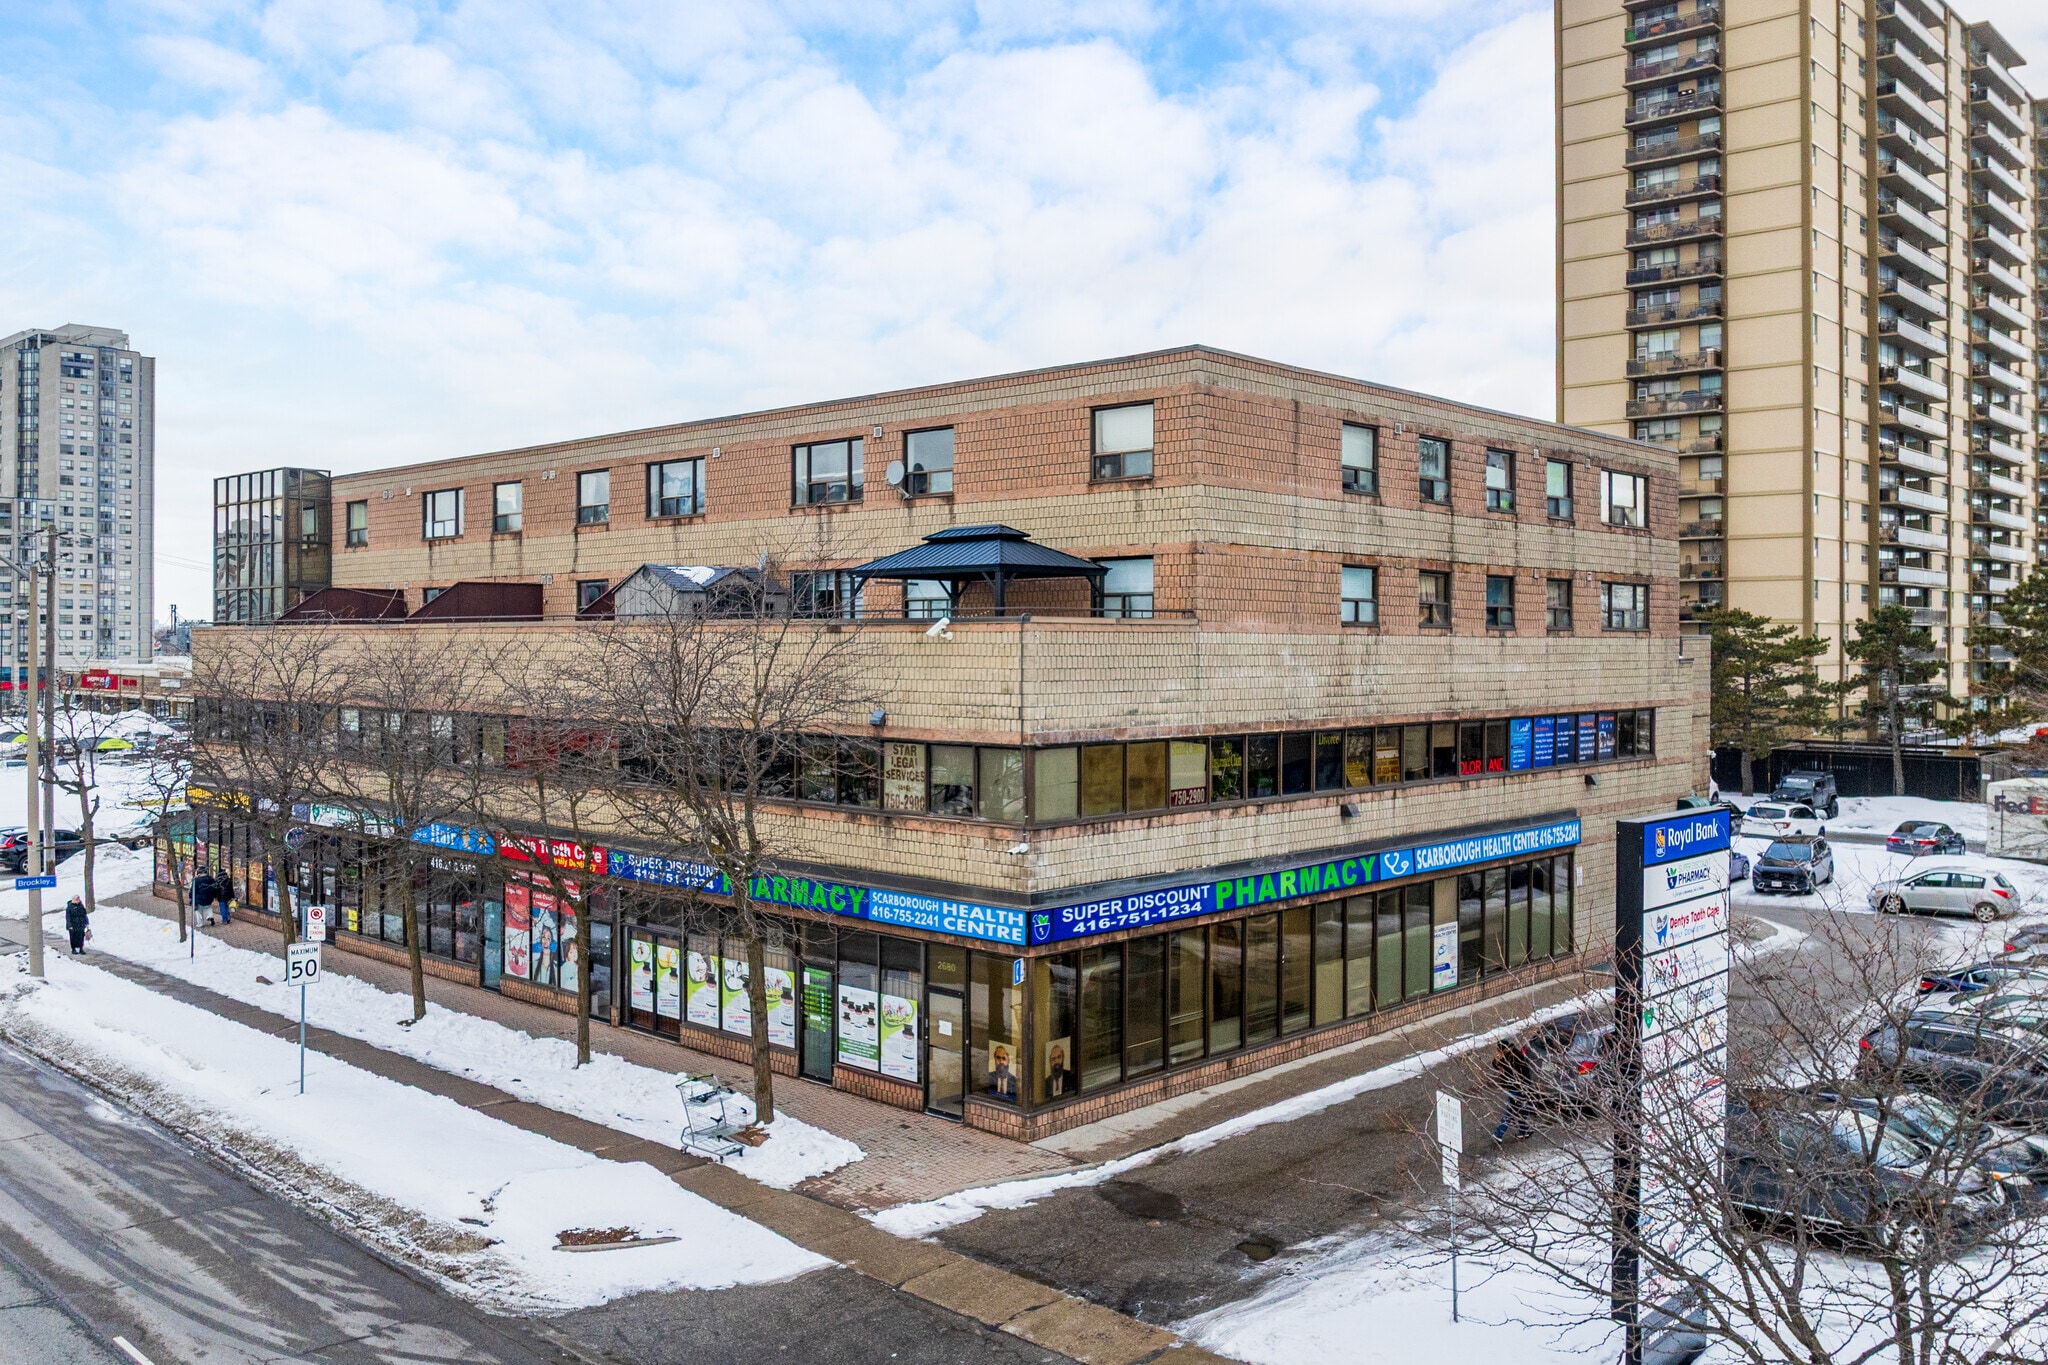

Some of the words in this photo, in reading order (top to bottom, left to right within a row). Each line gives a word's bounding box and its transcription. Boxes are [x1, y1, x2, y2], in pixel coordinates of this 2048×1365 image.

[893, 744, 917, 756] STAR
[891, 757, 918, 768] LEGAL
[885, 769, 925, 783] SERVICES
[885, 793, 925, 811] 750-2900
[431, 824, 457, 846] Hair
[1668, 822, 1694, 850] Royal
[1695, 818, 1718, 841] Bank
[1416, 841, 1482, 869] SCARBOROUGH
[1482, 834, 1512, 858] HEALTH
[1512, 830, 1540, 852] CENTRE
[1539, 823, 1580, 847] 416-755-2241
[628, 854, 664, 870] SUPER
[18, 879, 50, 887] Brockley
[1215, 855, 1377, 910] PHARMACY
[1678, 867, 1711, 884] PHARMACY
[872, 891, 939, 912] SCARBOROUGH
[1062, 900, 1123, 923] SUPER
[1127, 884, 1211, 911] DISCOUNT
[871, 908, 940, 928] 416-755-2241
[942, 901, 1024, 927] HEALTH
[1072, 902, 1203, 933] 416-751-1234
[1670, 915, 1690, 929] Dentys
[1690, 907, 1706, 922] Tooth
[1707, 906, 1720, 918] Care
[943, 916, 1022, 942] CENTRE
[291, 947, 318, 956] MAXIMUM
[291, 959, 317, 979] 50
[937, 961, 956, 972] 2680
